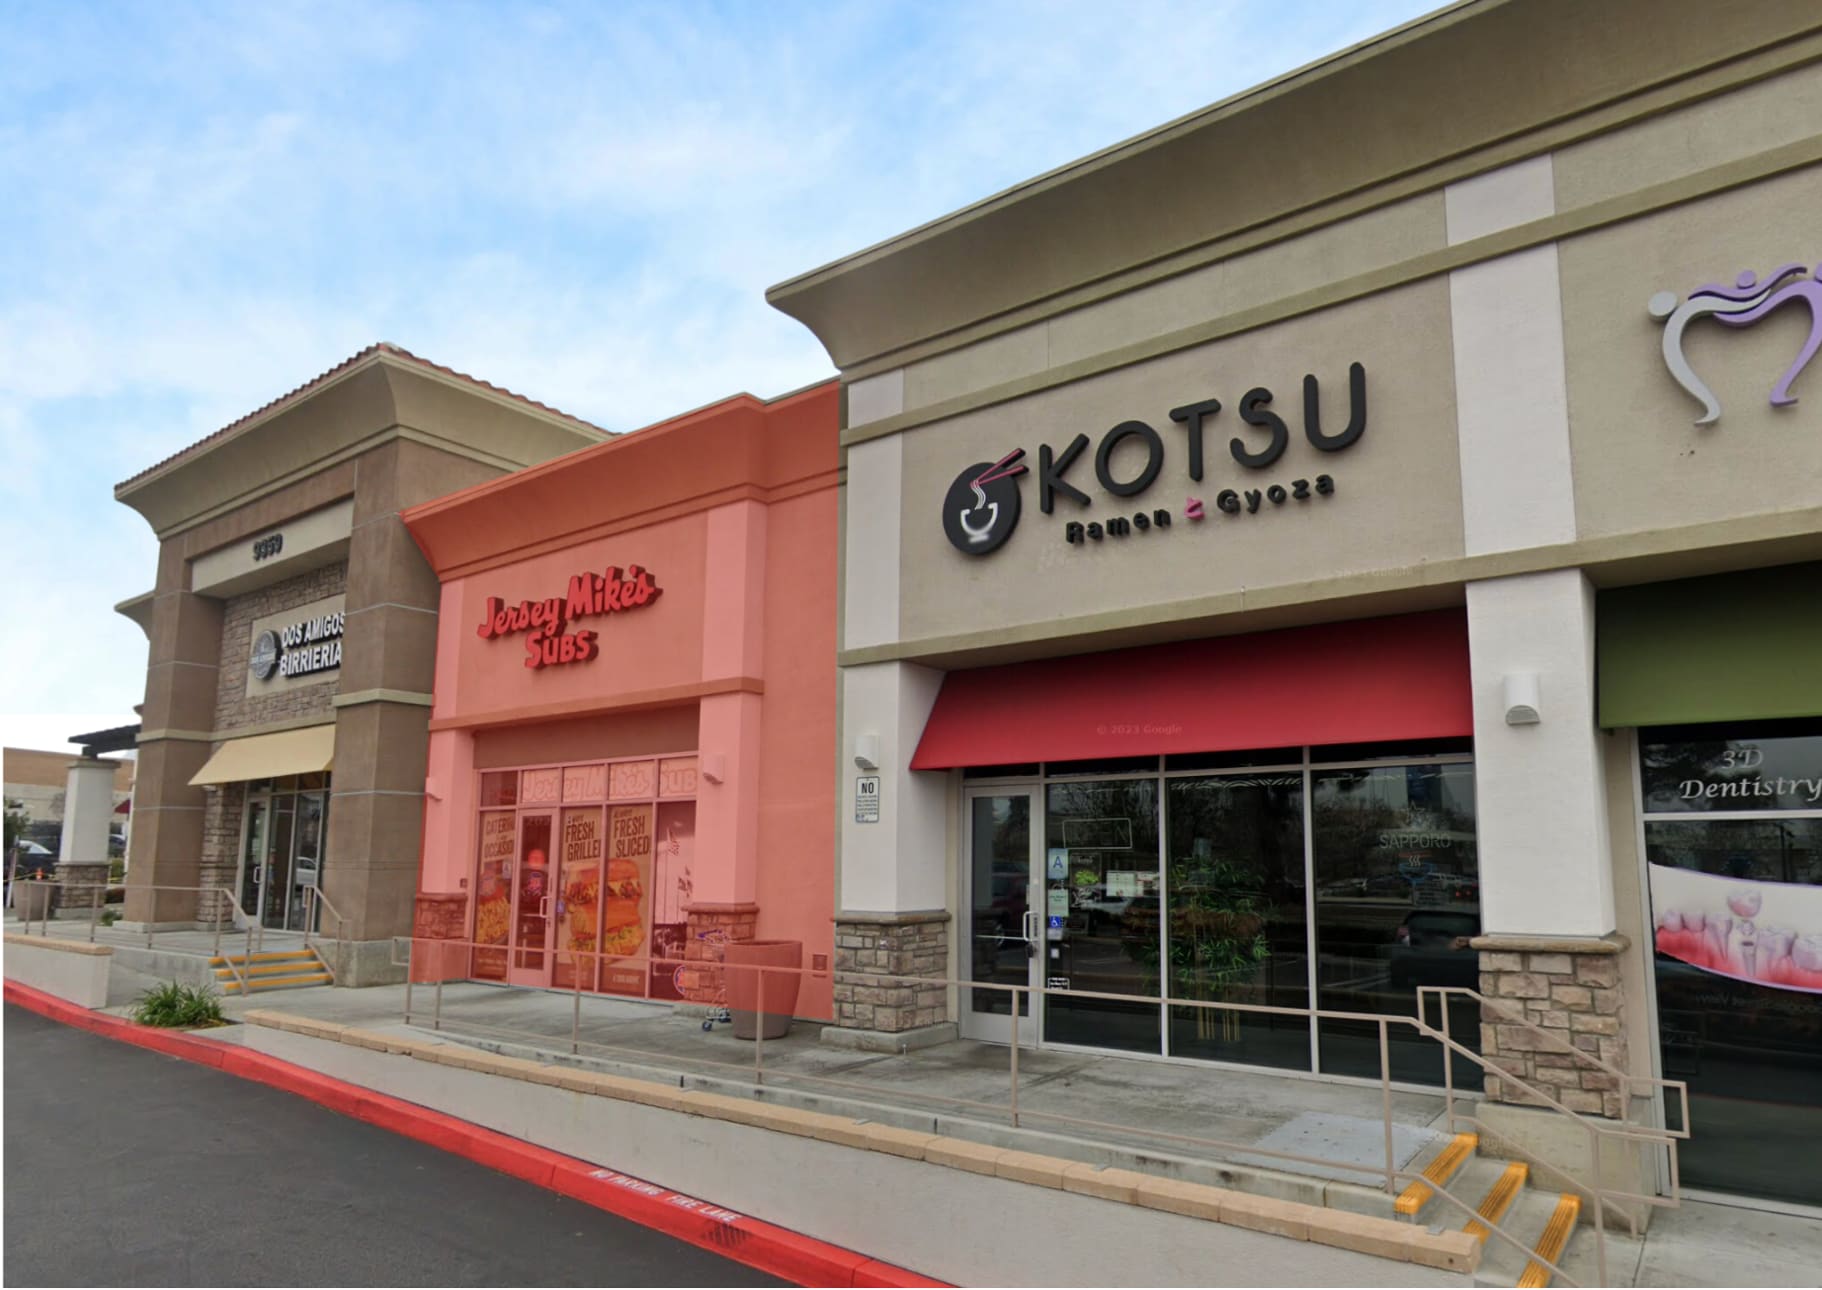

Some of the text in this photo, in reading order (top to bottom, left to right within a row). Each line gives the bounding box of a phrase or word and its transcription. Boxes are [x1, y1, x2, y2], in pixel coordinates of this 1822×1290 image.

[1038, 361, 1366, 515] KOTSU
[1065, 507, 1171, 545] Ramen
[1216, 473, 1335, 515] Gyoza
[477, 564, 657, 639] Jersey Mike's
[282, 613, 345, 648] DOS AMIGOS
[280, 642, 342, 676] BIRRIERIA
[1722, 749, 1763, 769] 3D
[861, 782, 875, 794] NO
[1679, 775, 1822, 802] Dentistry
[566, 820, 595, 843] FRESH
[613, 815, 646, 839] FRESH
[615, 835, 650, 858] SLICED
[1380, 834, 1451, 849] SAPPORO
[1053, 856, 1063, 869] A
[665, 1194, 704, 1209] FIRE
[700, 1206, 744, 1222] LANE
